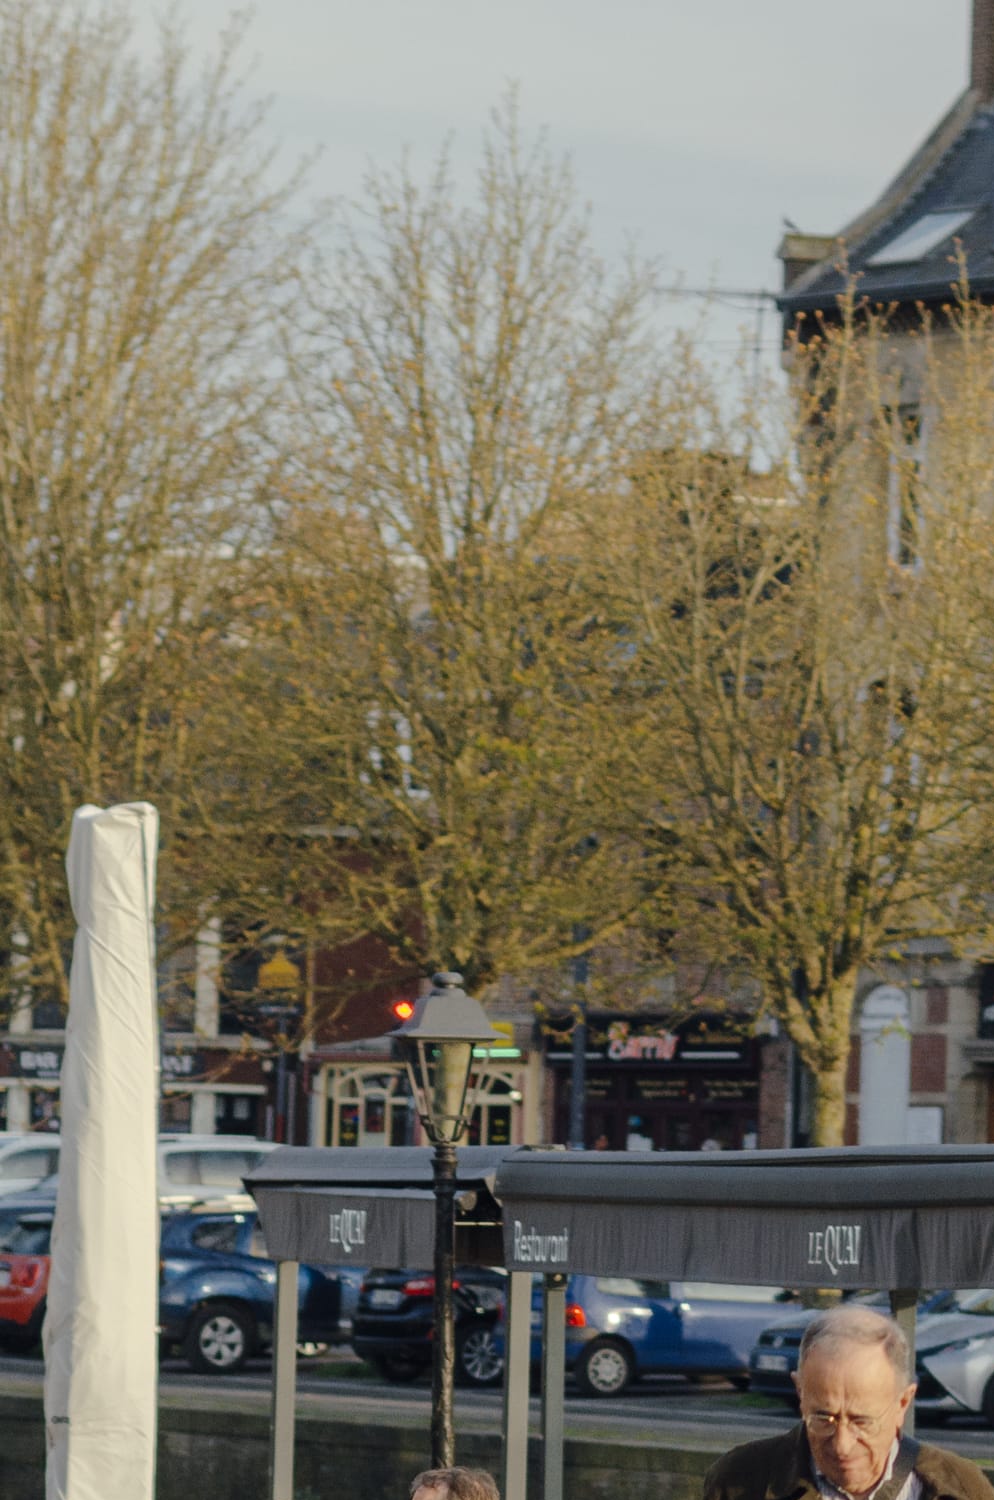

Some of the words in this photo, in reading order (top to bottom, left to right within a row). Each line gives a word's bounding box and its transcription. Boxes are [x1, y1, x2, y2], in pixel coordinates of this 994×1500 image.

[329, 1214, 341, 1243] LE
[341, 1208, 367, 1252] QUAI
[514, 1220, 569, 1262] Restaurant
[808, 1232, 823, 1264] LE
[824, 1225, 861, 1275] QUAI
